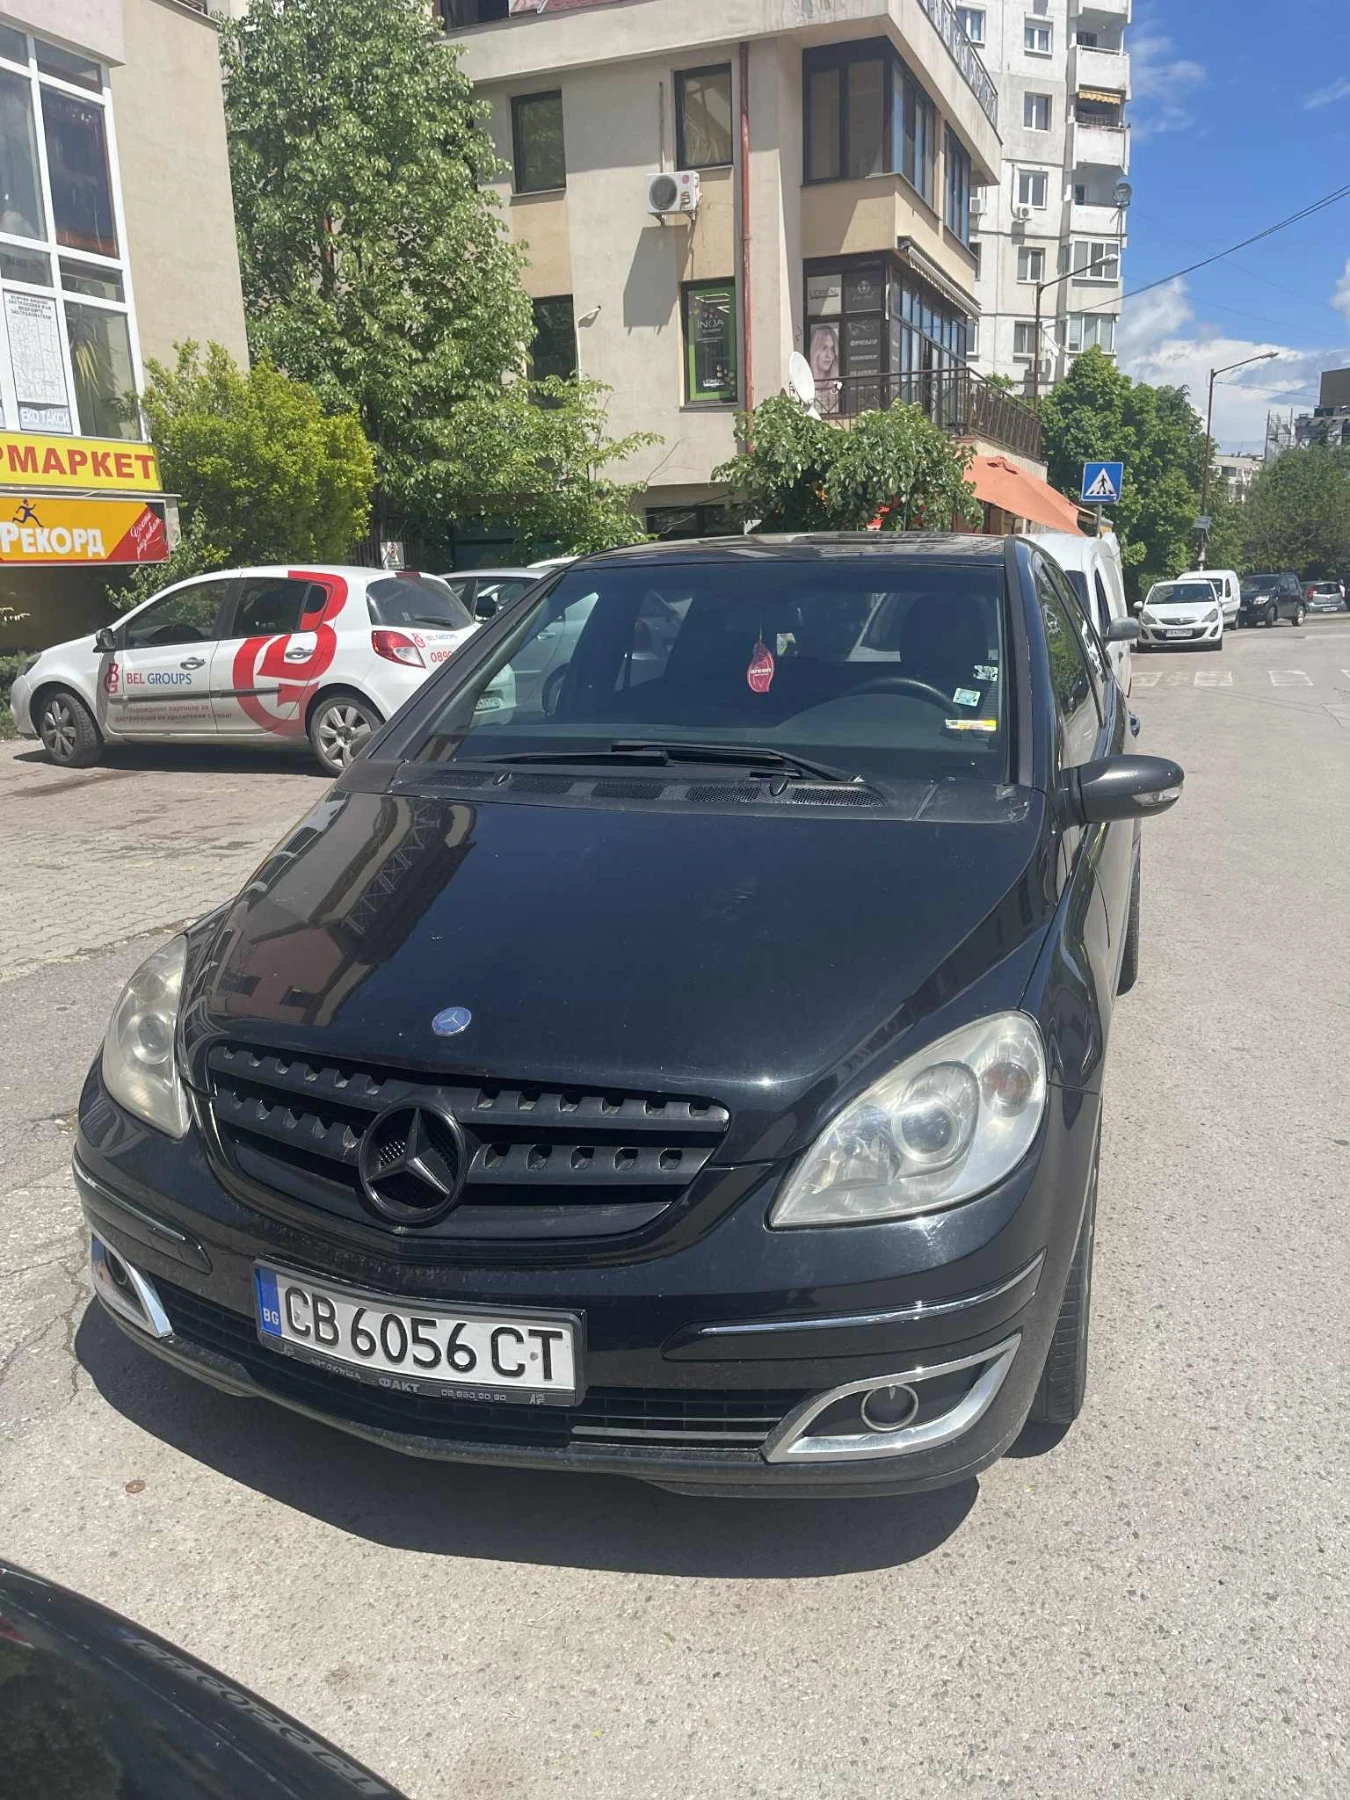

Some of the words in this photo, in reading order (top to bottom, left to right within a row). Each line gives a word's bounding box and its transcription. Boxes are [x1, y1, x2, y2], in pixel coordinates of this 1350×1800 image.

[21, 409, 39, 423] ЕКО
[41, 410, 70, 428] ТАКСИ
[0, 444, 155, 479] МАРКЕТ
[126, 672, 146, 685] BEL
[147, 672, 192, 685] GROUPS
[263, 1308, 280, 1327] BG
[284, 1286, 341, 1348] CB
[350, 1307, 478, 1374] 6056
[490, 1326, 564, 1382] CT
[378, 1377, 420, 1394] ФАКТ
